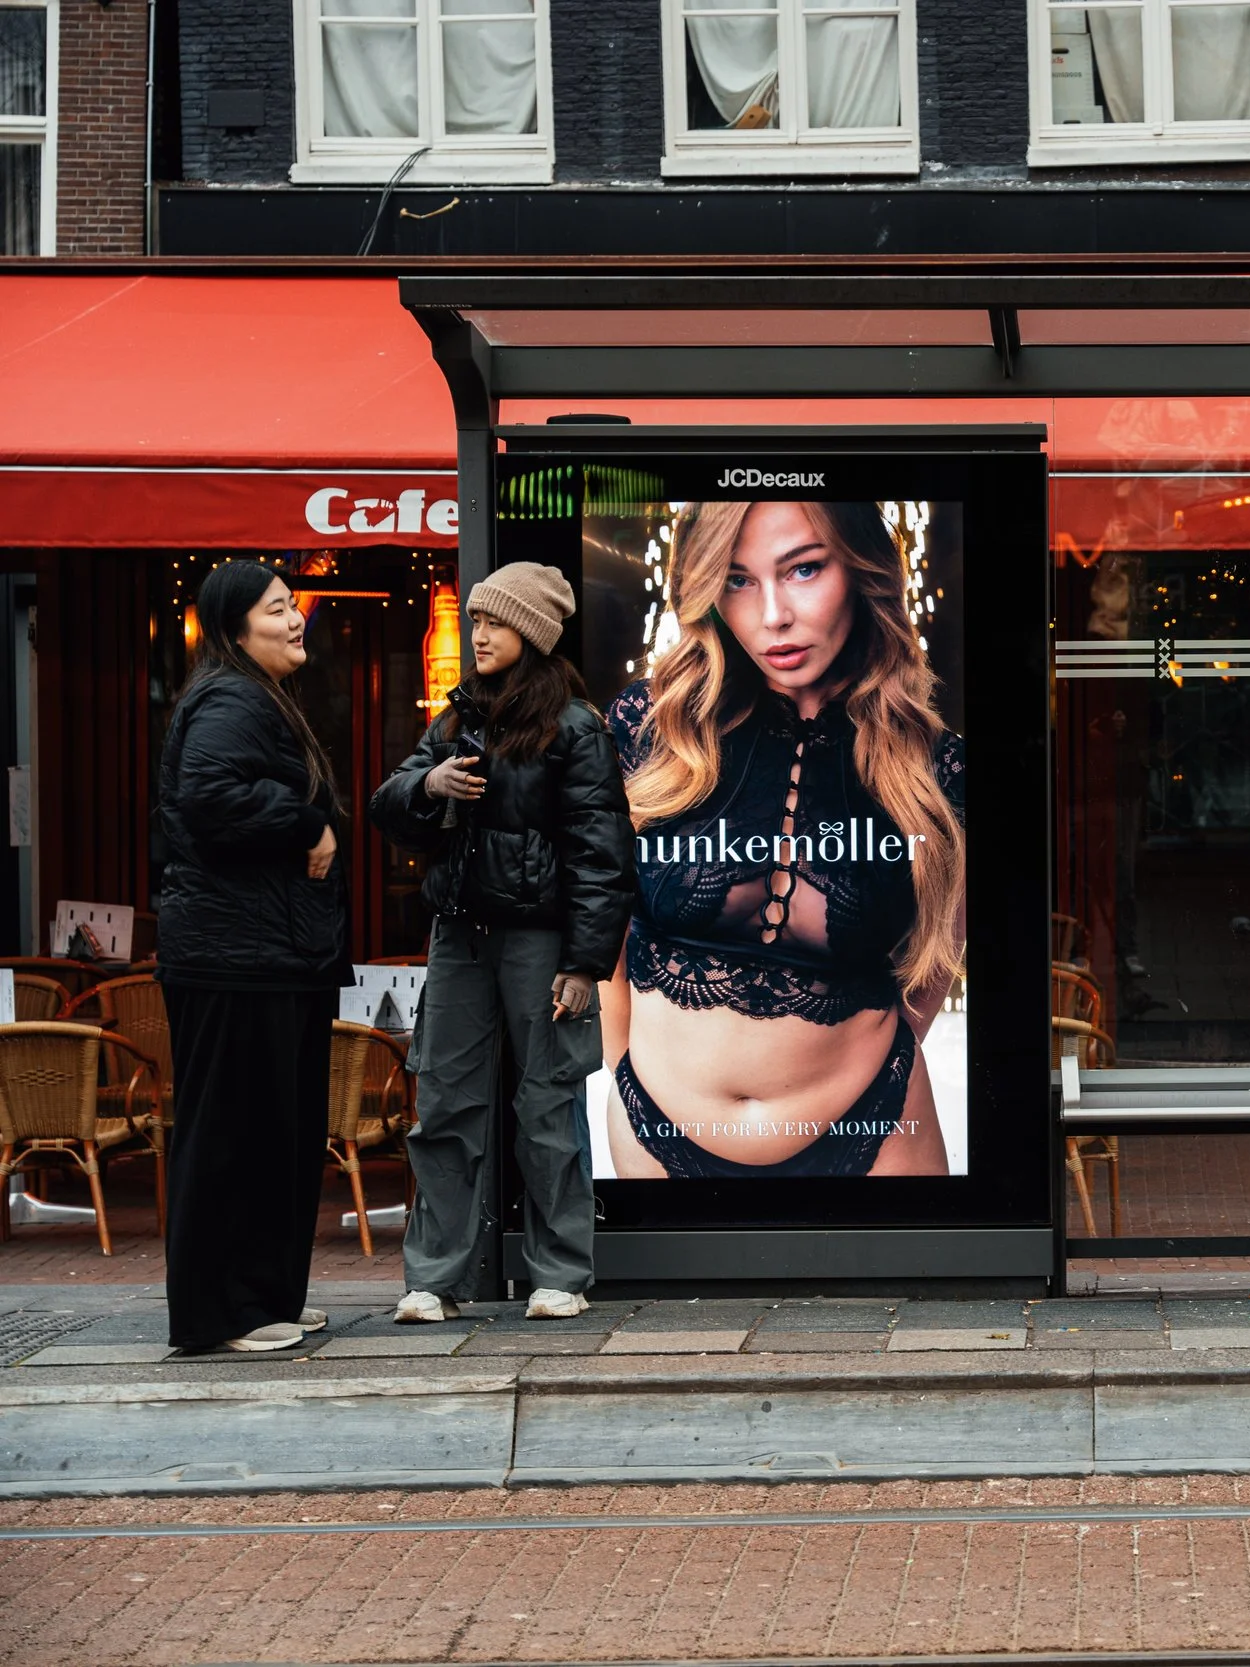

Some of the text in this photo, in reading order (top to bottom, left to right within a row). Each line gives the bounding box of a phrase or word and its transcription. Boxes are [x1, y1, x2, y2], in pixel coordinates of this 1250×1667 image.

[718, 468, 825, 487] JCDecaux
[636, 818, 926, 863] unkemöller
[638, 1120, 920, 1137] A GIFT FOR EVERY MOMENT
